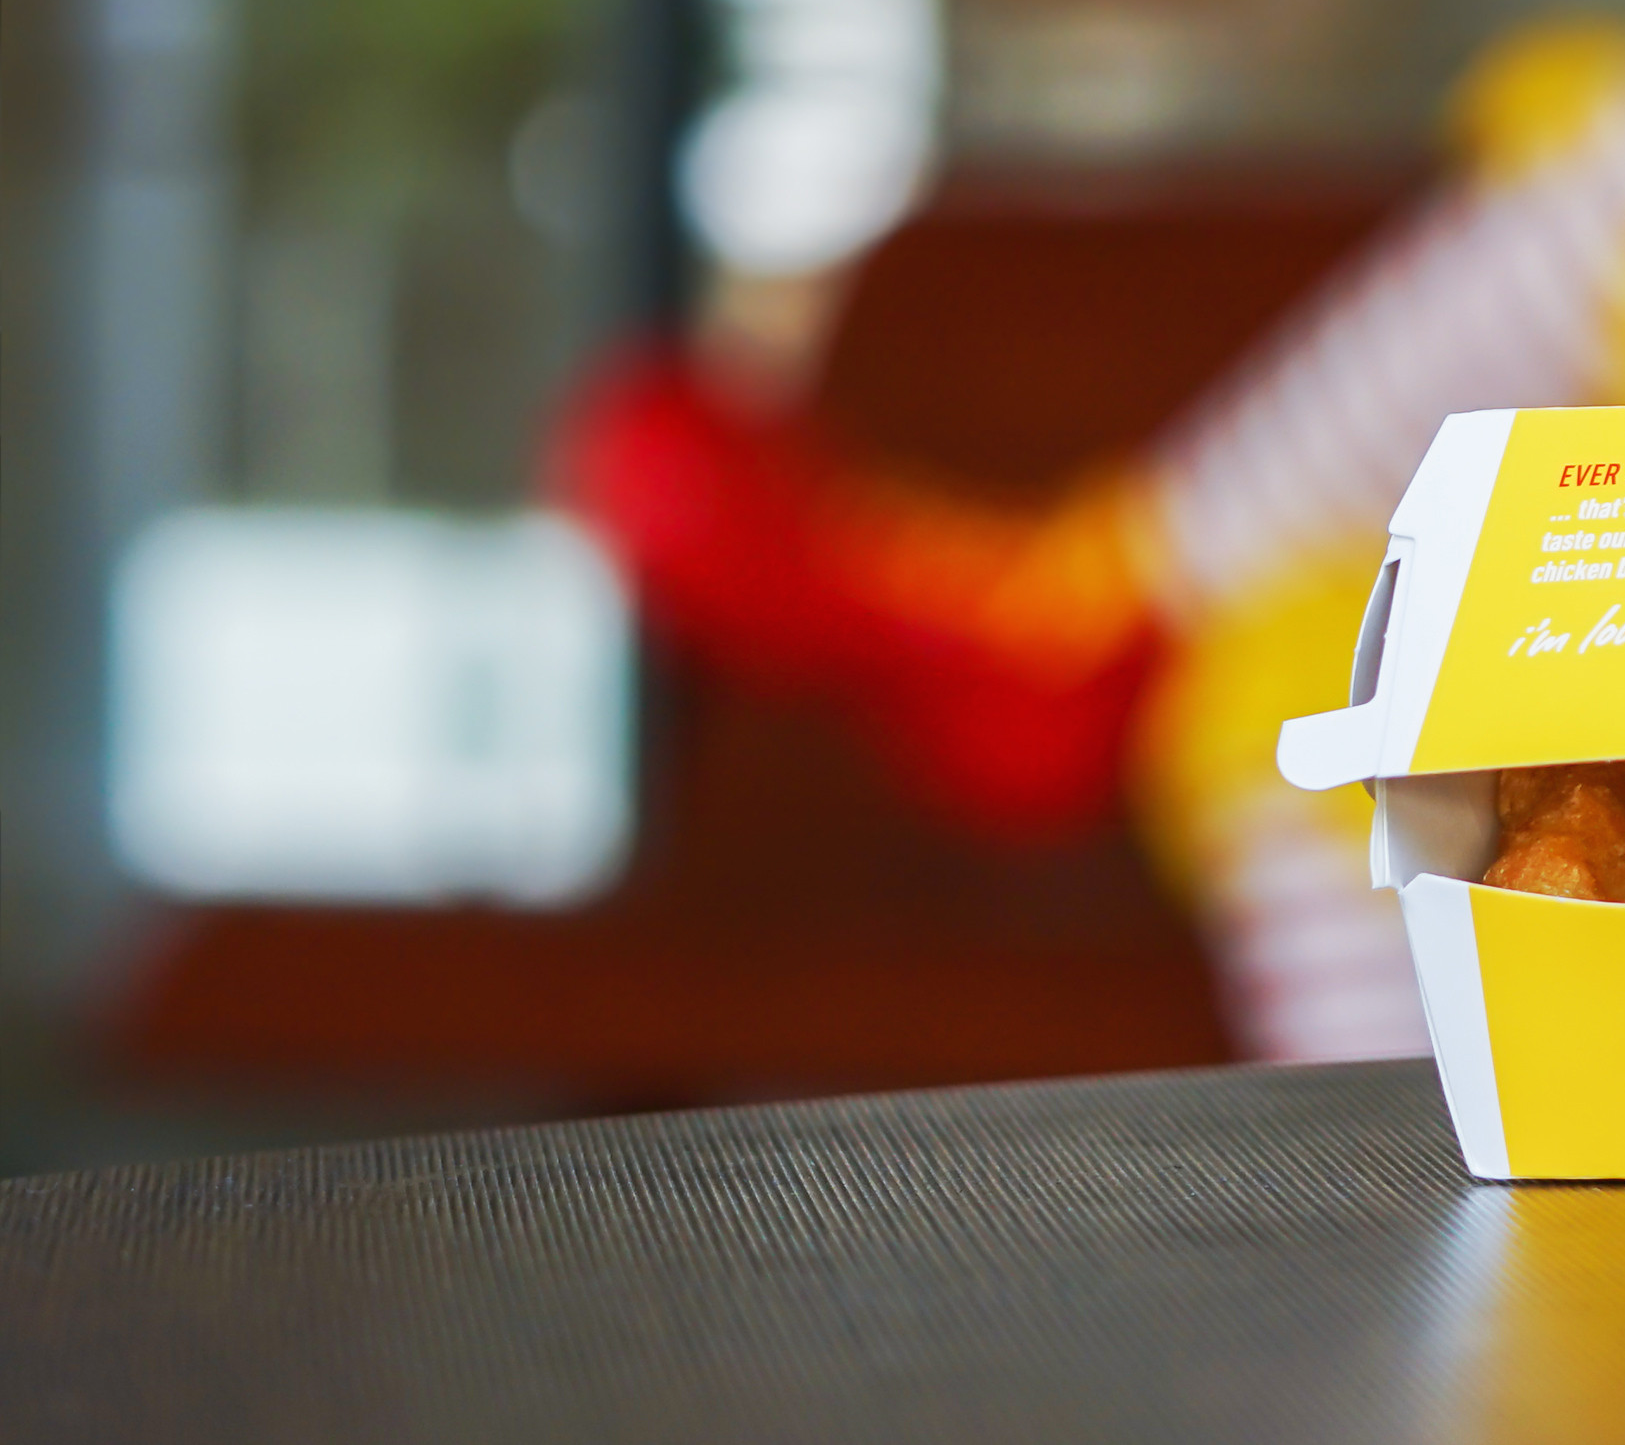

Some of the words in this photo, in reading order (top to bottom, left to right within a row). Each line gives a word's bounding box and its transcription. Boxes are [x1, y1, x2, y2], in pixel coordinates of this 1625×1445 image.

[1558, 463, 1621, 488] EVER
[1541, 531, 1595, 552] taste
[1530, 558, 1613, 583] chicken
[1507, 617, 1571, 657] i'm
